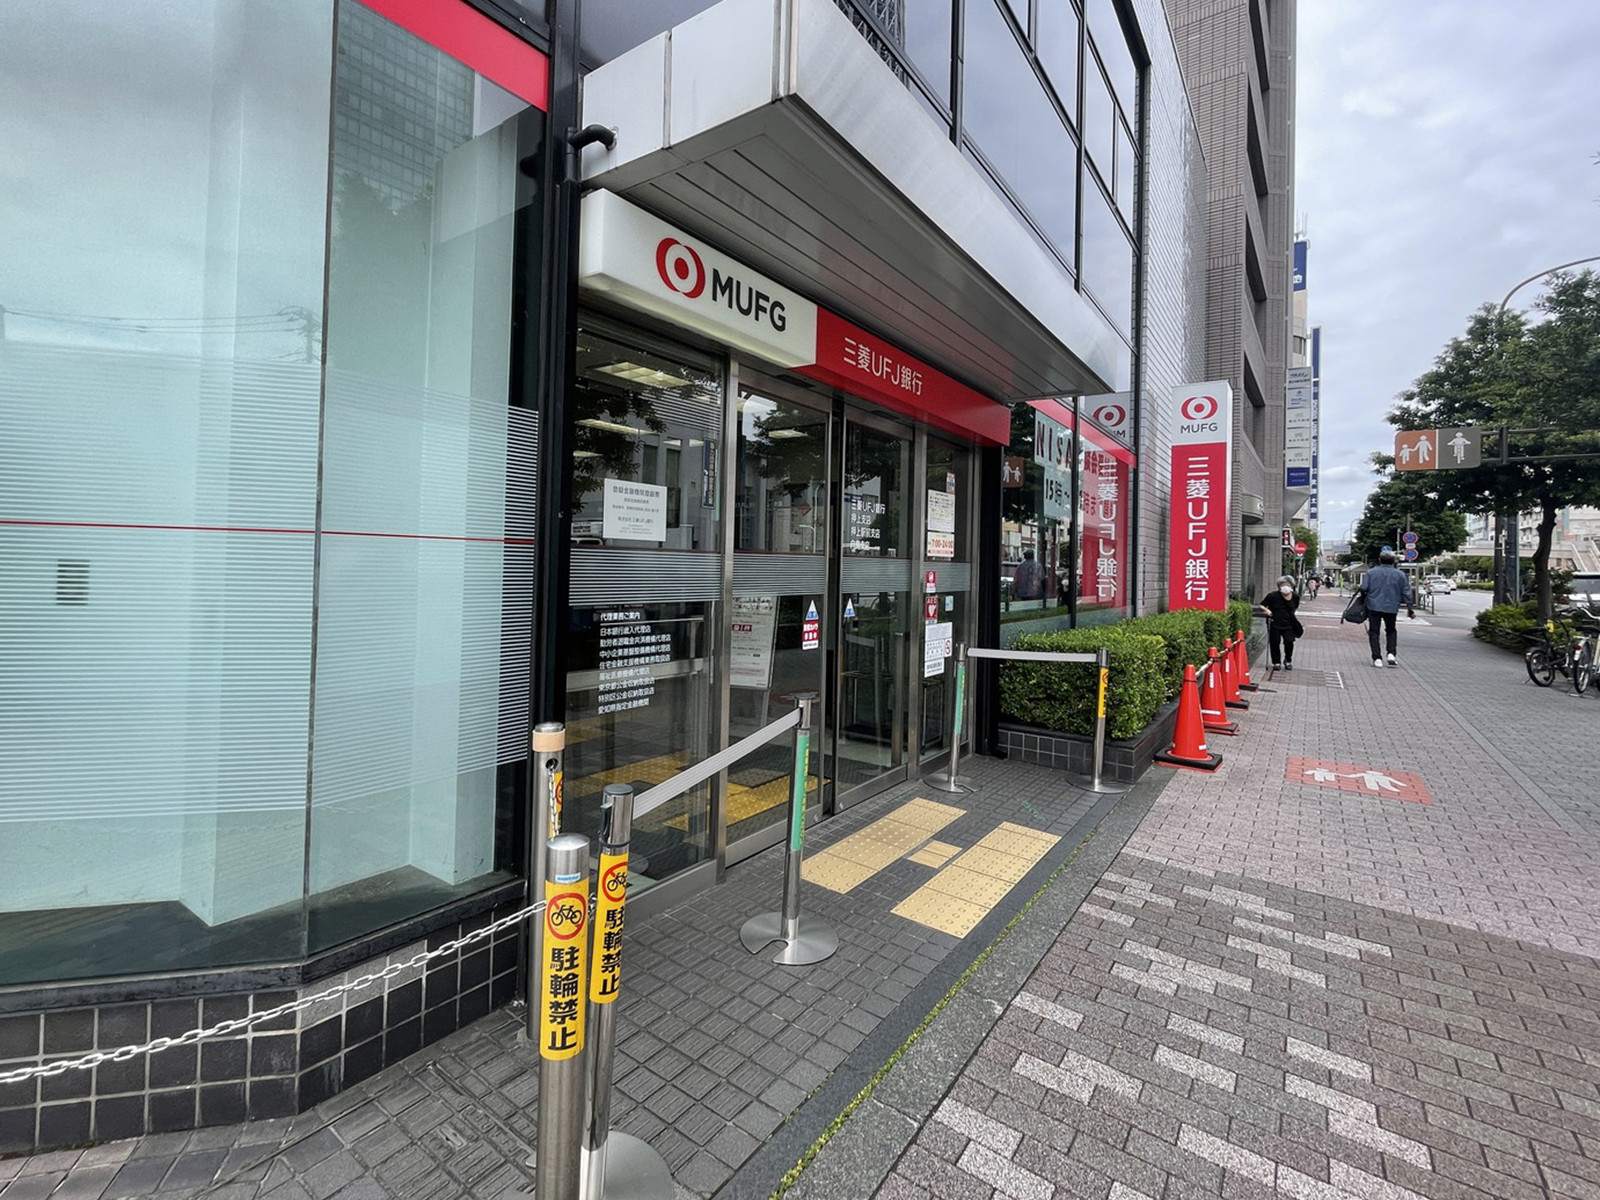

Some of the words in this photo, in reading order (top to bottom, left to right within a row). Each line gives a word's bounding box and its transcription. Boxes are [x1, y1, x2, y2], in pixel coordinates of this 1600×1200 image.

[712, 268, 787, 332] MUFG
[843, 337, 923, 395] 三菱UFJ銀行
[1036, 421, 1072, 470] NISA
[1180, 422, 1218, 434] MUFG
[851, 499, 886, 515] 三菱UFJ銀行
[851, 513, 872, 525] 押上支店
[1185, 456, 1210, 601] 三菱UFJ銀行
[599, 908, 624, 996] 駐輪禁止
[548, 945, 580, 1051] 駐輪禁止
